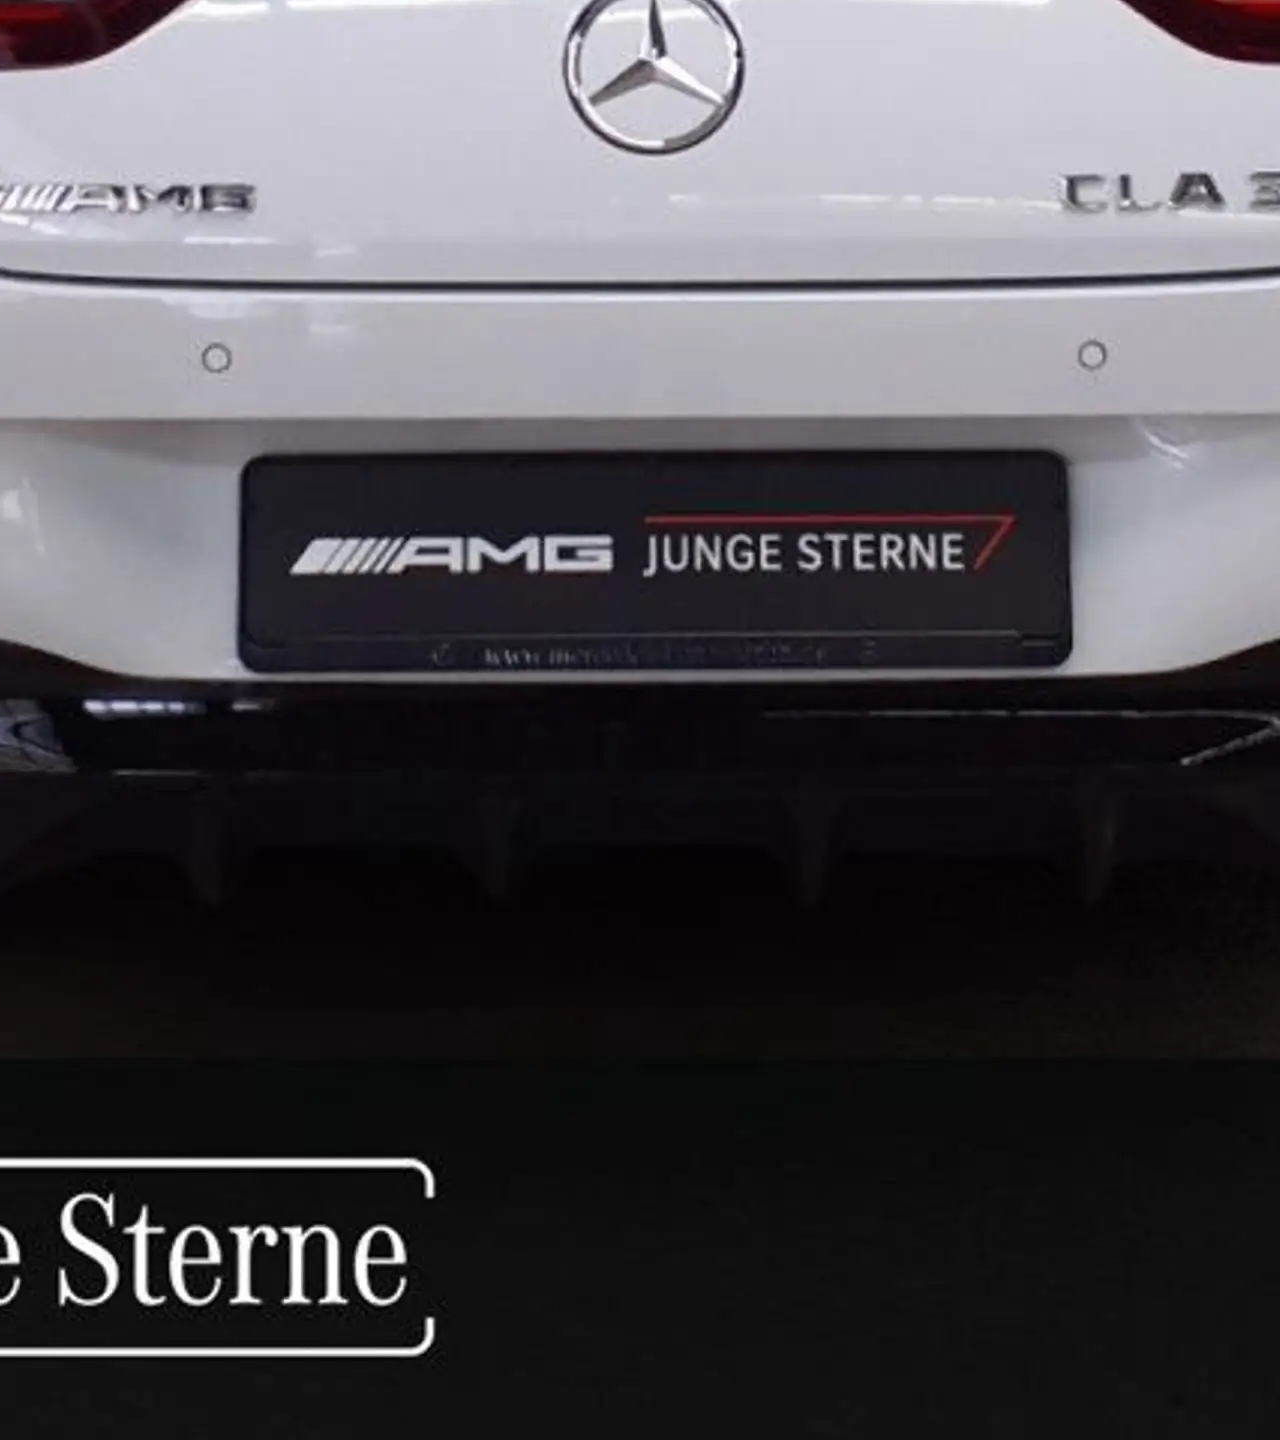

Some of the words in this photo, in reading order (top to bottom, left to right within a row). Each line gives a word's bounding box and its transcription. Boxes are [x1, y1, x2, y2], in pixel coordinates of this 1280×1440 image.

[1063, 173, 1225, 210] CLA
[386, 534, 614, 575] AMG
[642, 533, 783, 577] JUNGE
[796, 533, 965, 572] STERNE
